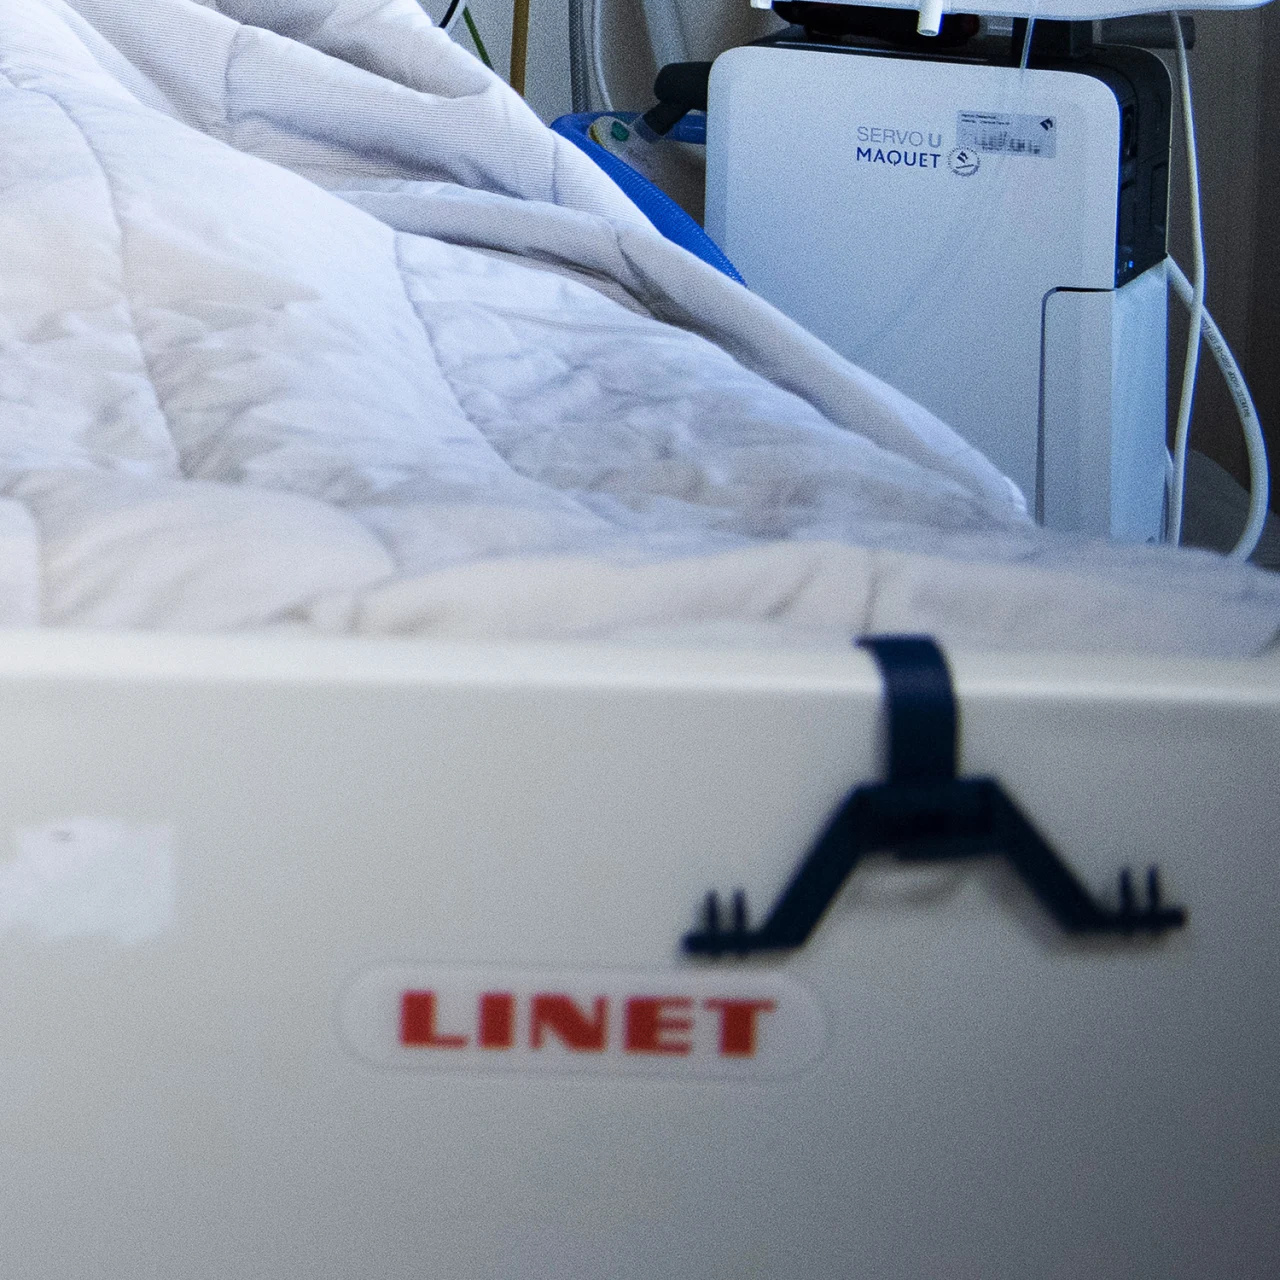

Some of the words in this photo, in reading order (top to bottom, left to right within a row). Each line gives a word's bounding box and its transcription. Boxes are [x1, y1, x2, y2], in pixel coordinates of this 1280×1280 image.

[856, 126, 922, 147] SERVO
[927, 129, 942, 149] U
[856, 146, 941, 169] MAQUET
[398, 989, 779, 1058] LINET
